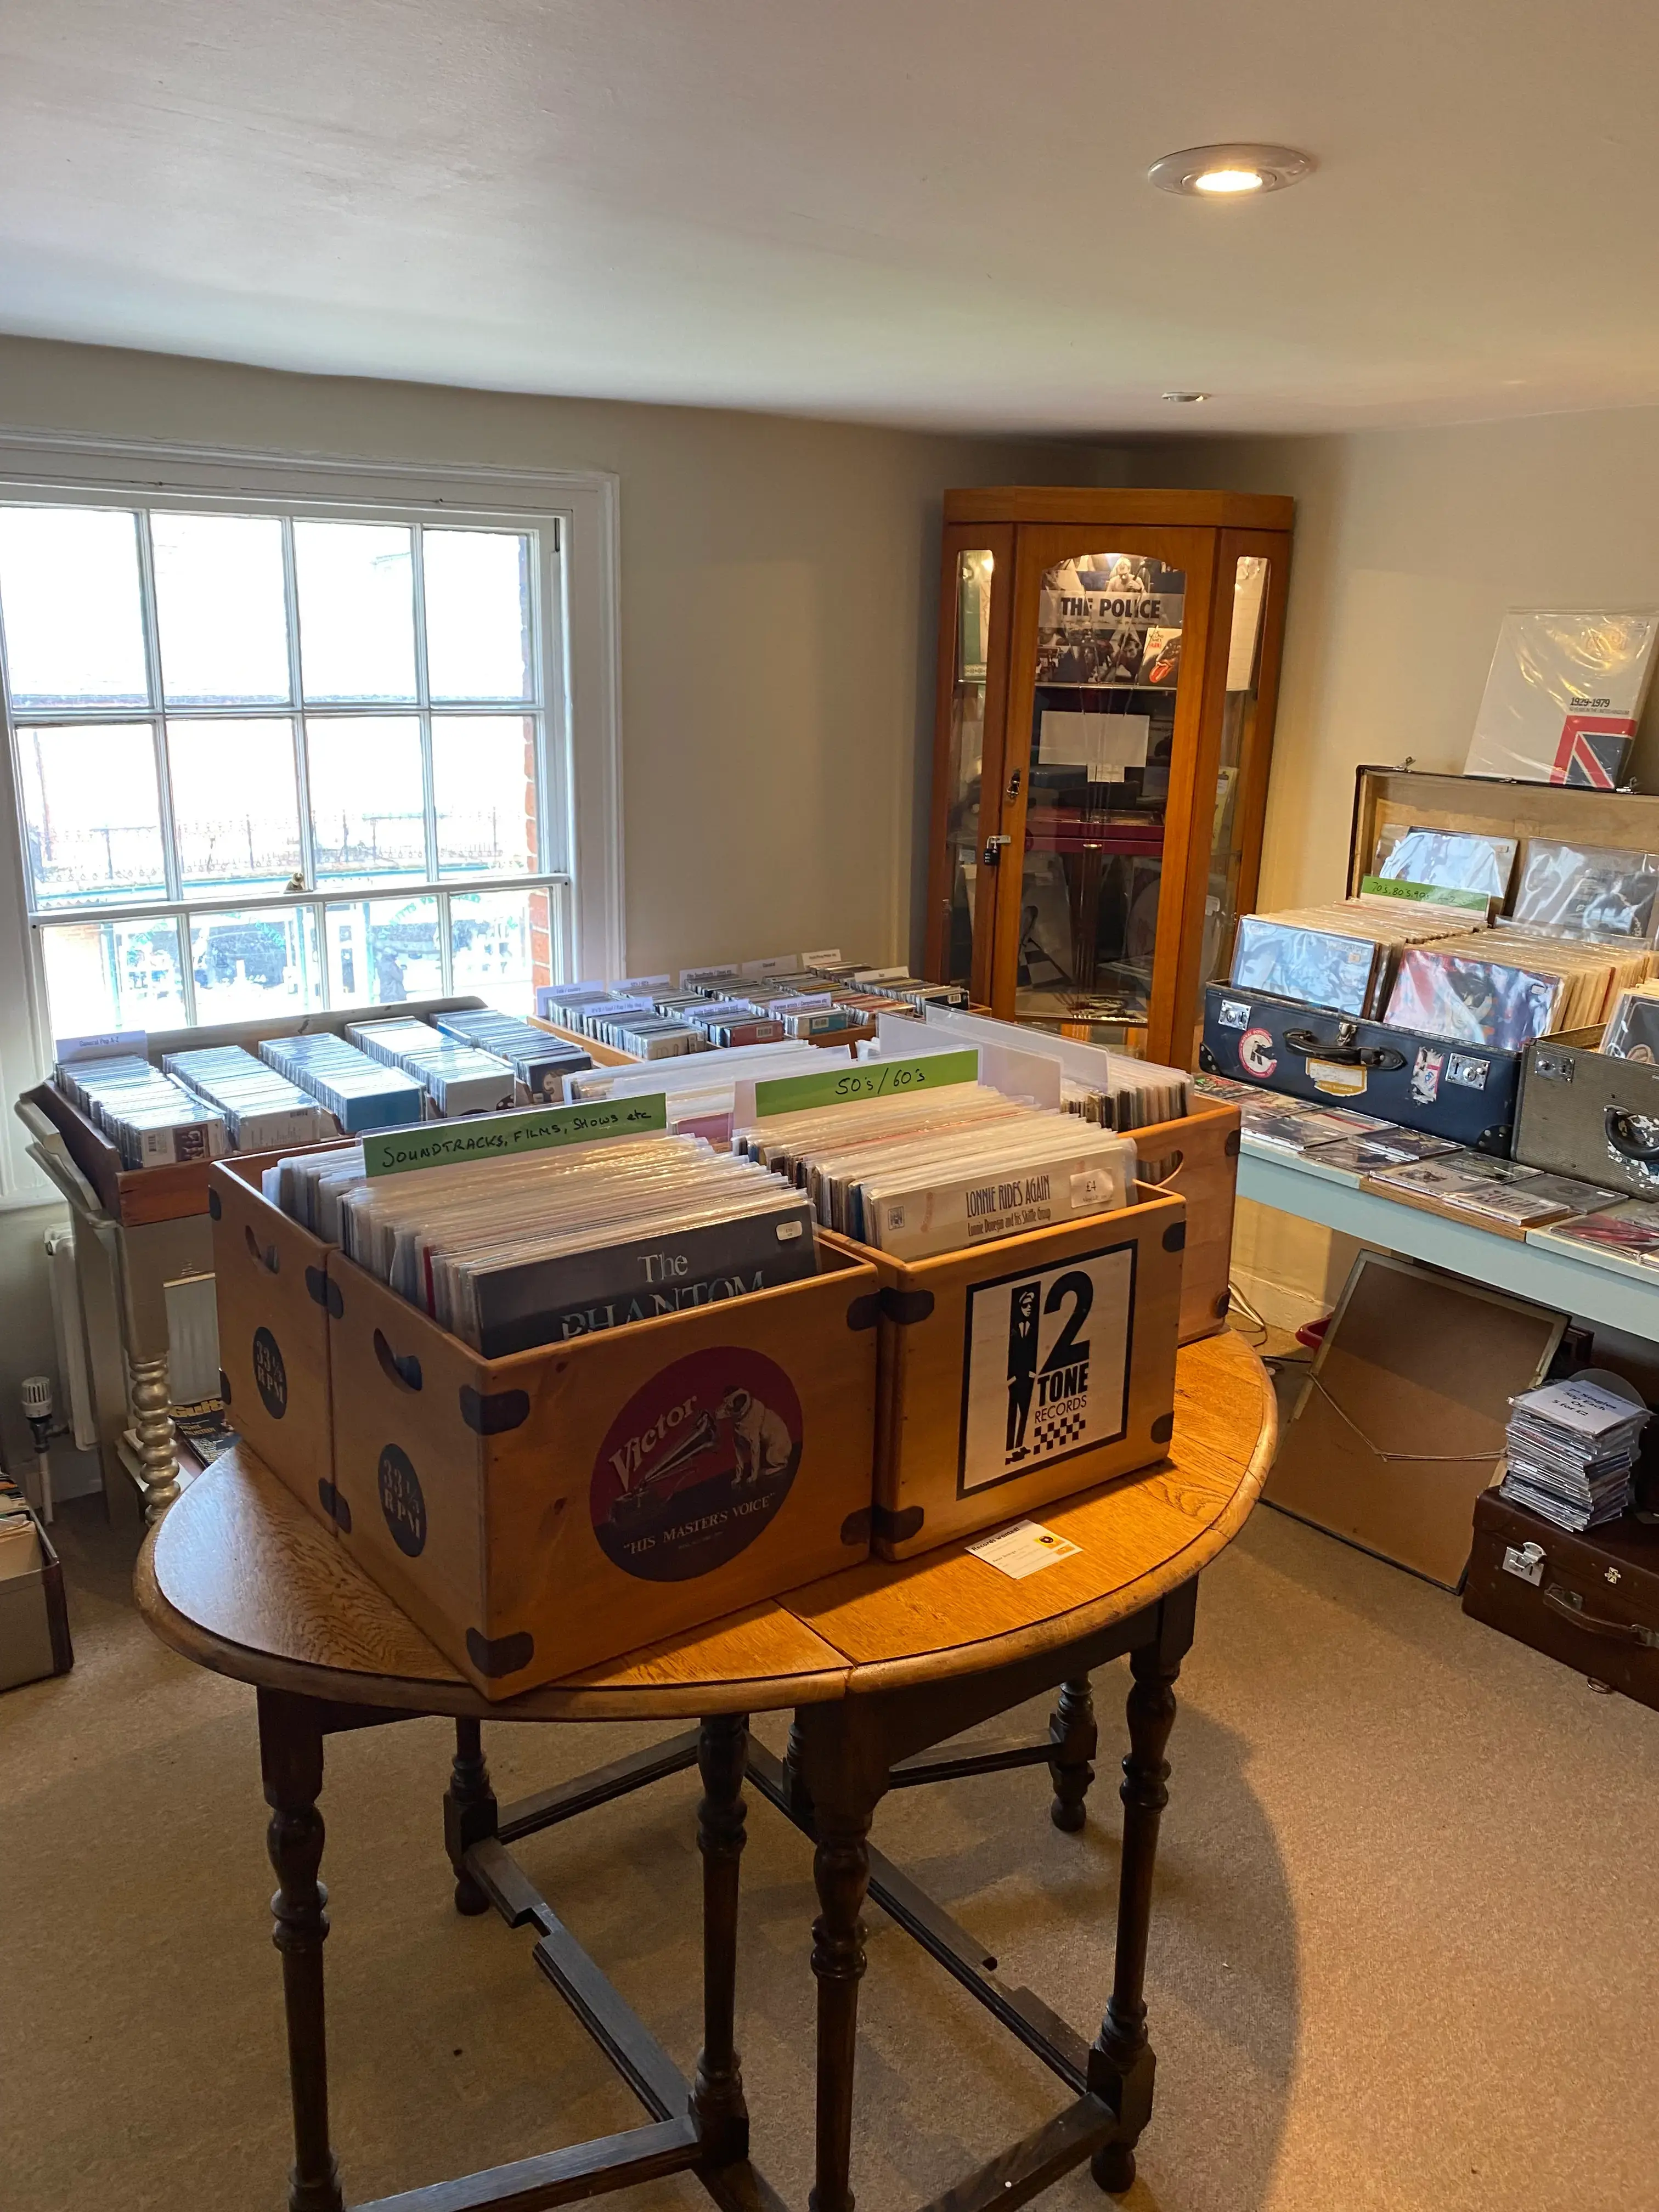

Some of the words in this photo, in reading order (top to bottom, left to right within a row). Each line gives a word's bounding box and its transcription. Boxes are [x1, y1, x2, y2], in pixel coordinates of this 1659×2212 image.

[1060, 597, 1093, 616] THE
[1099, 598, 1161, 619] POLICE
[1570, 697, 1610, 708] 1929-1979
[966, 1186, 996, 1218] LONNIE
[998, 1180, 1023, 1211] RIDES
[1025, 1175, 1051, 1205] AGAIN
[1086, 1180, 1097, 1192] £4
[1005, 1215, 1014, 1228] and
[637, 1251, 688, 1283] The
[1037, 1270, 1093, 1376] 2
[257, 1365, 284, 1404] RPM
[1036, 1362, 1090, 1407] TONE
[1034, 1395, 1087, 1424] RECORDS
[608, 1398, 697, 1492] Victor
[385, 1488, 420, 1539] RPM
[971, 1539, 996, 1551] Records
[996, 1527, 1020, 1540] wanted!
